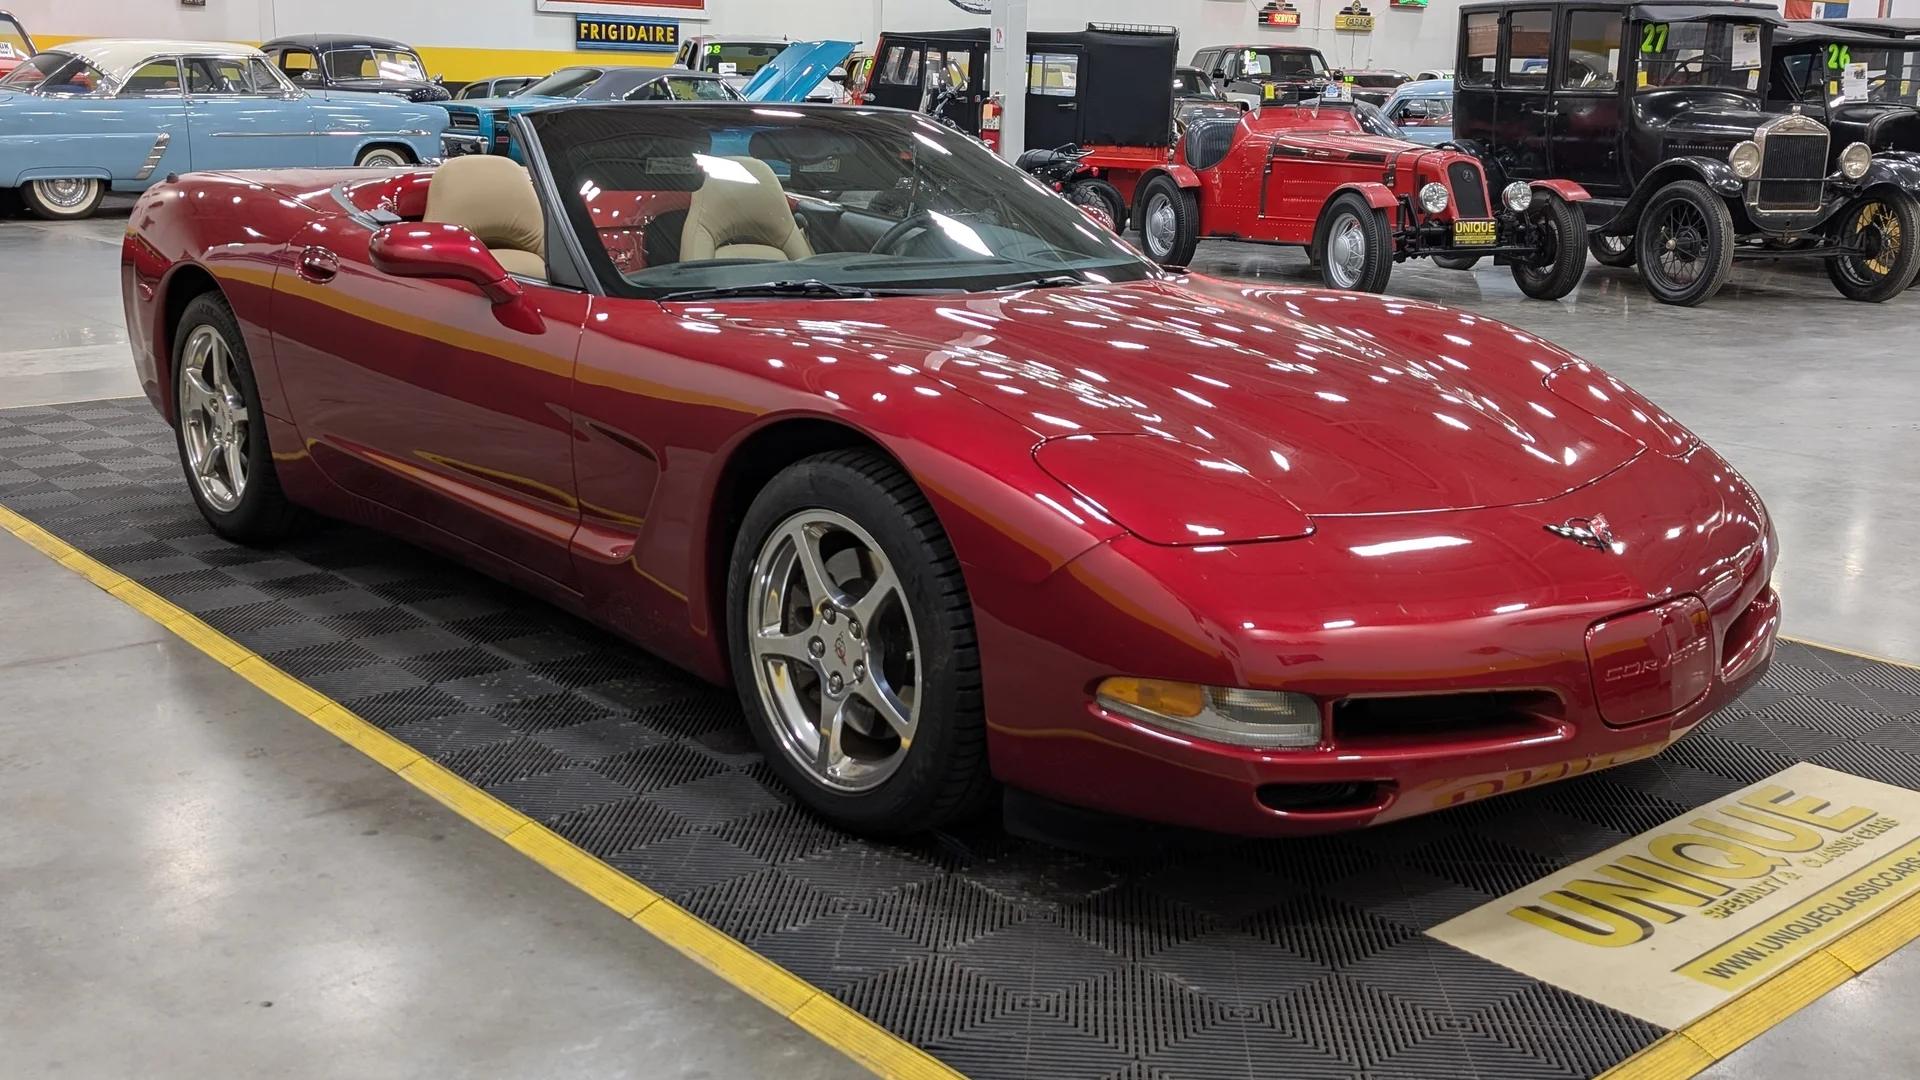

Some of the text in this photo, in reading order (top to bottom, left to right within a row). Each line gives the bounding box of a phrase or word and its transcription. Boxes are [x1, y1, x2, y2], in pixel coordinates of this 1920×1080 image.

[580, 23, 675, 42] FRIGIDAIRE
[1641, 23, 1668, 53] 27
[1828, 44, 1851, 69] 26
[1455, 221, 1496, 233] UNIQUE
[1507, 784, 1879, 948] UNIQUE
[1800, 836, 1865, 869] CLASSIC
[1702, 850, 1920, 980] WWW.UNIQUECLASSICCARS
